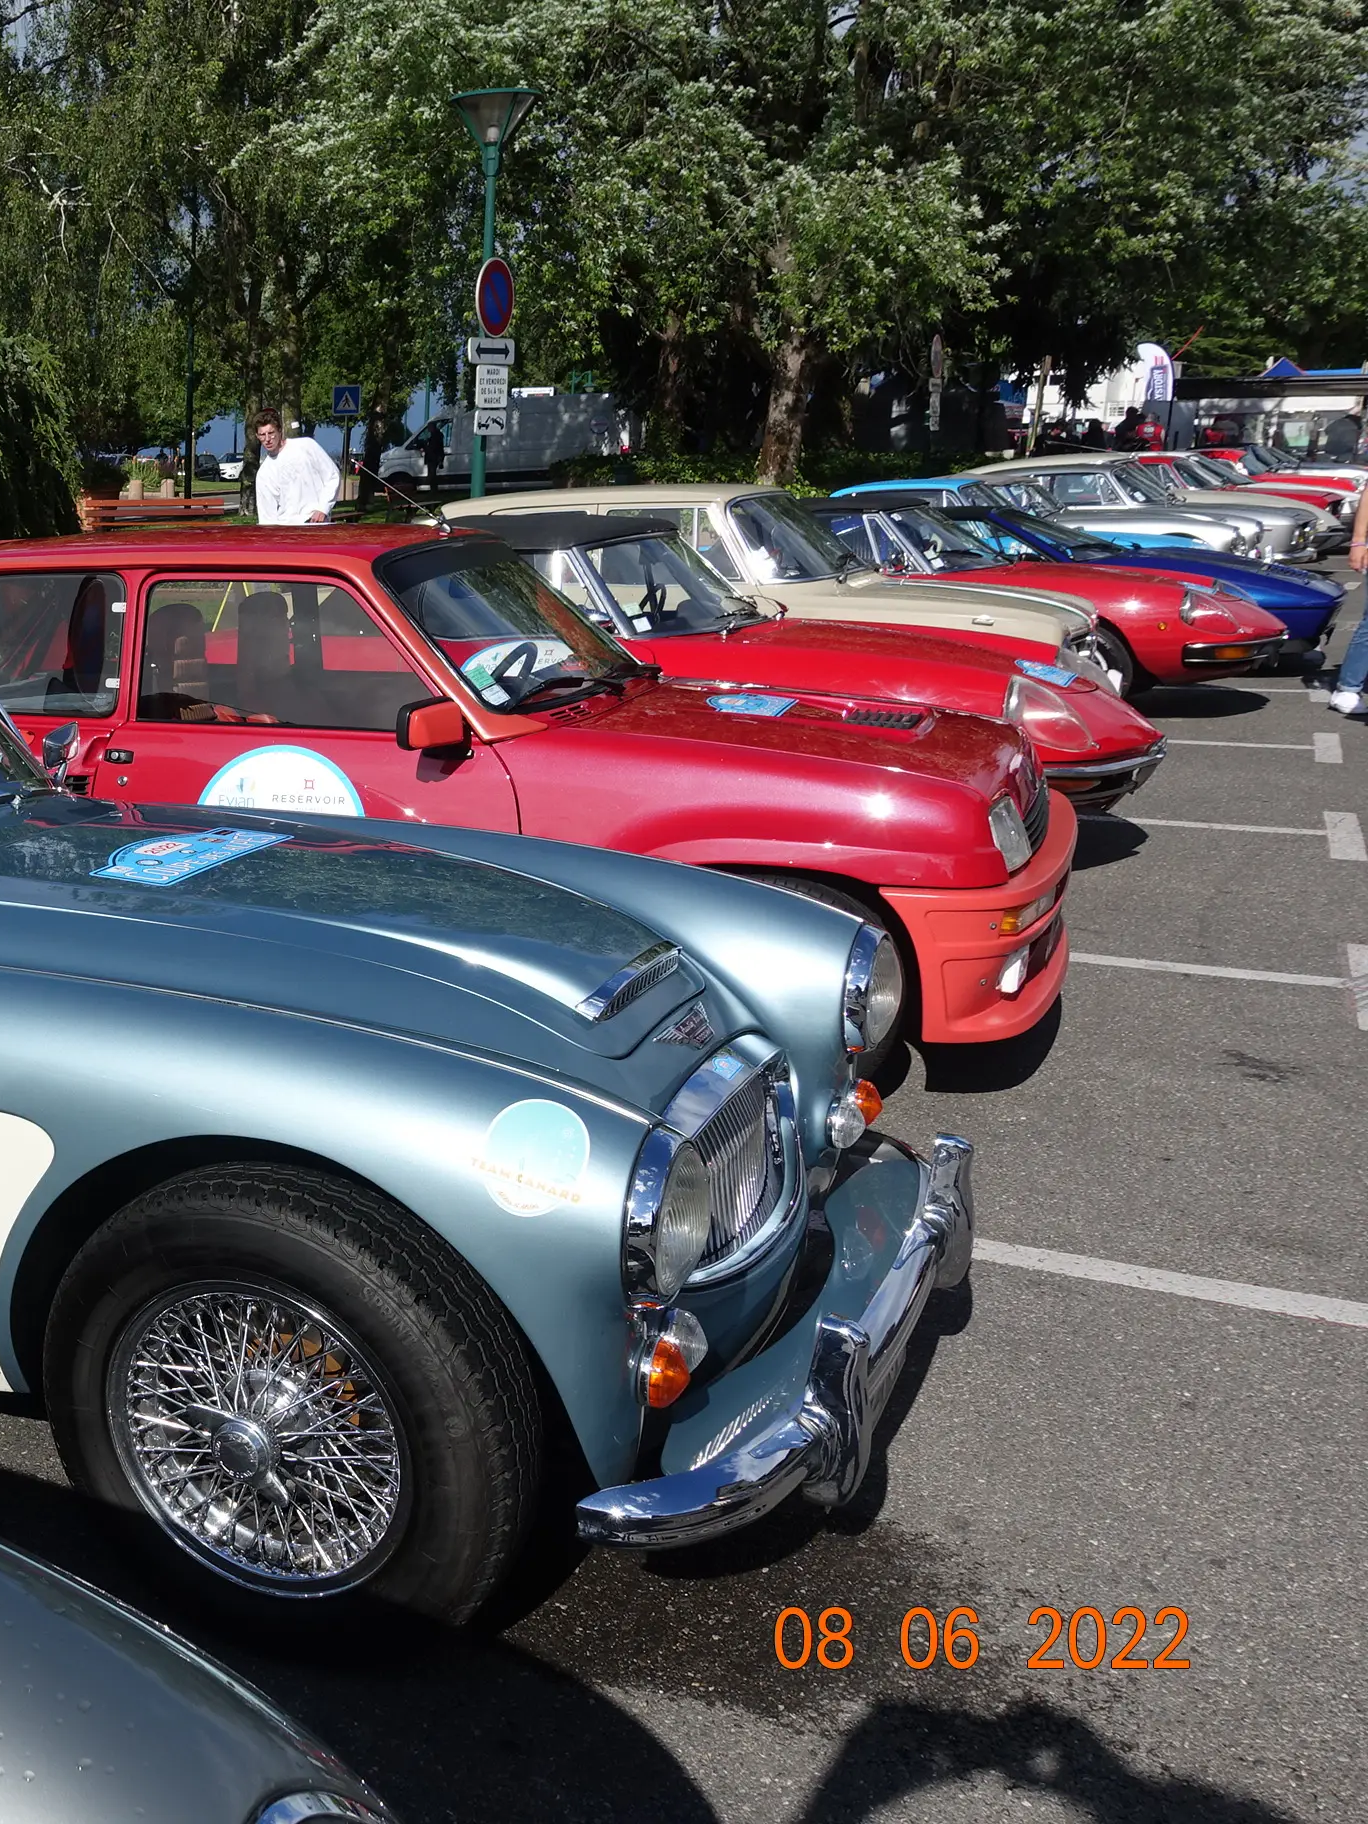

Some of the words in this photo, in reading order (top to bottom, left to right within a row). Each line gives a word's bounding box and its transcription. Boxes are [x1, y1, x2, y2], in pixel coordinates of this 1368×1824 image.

[486, 368, 501, 376] MARDI
[479, 377, 485, 386] ET
[486, 377, 507, 386] VENDREDI
[480, 387, 487, 395] DE
[483, 396, 502, 405] MARCHÉ
[271, 794, 346, 805] RESERVOIR
[143, 842, 183, 855] 2022
[124, 858, 209, 881] COUPE
[471, 1156, 512, 1181] TEAM
[516, 1173, 583, 1204] CANARD
